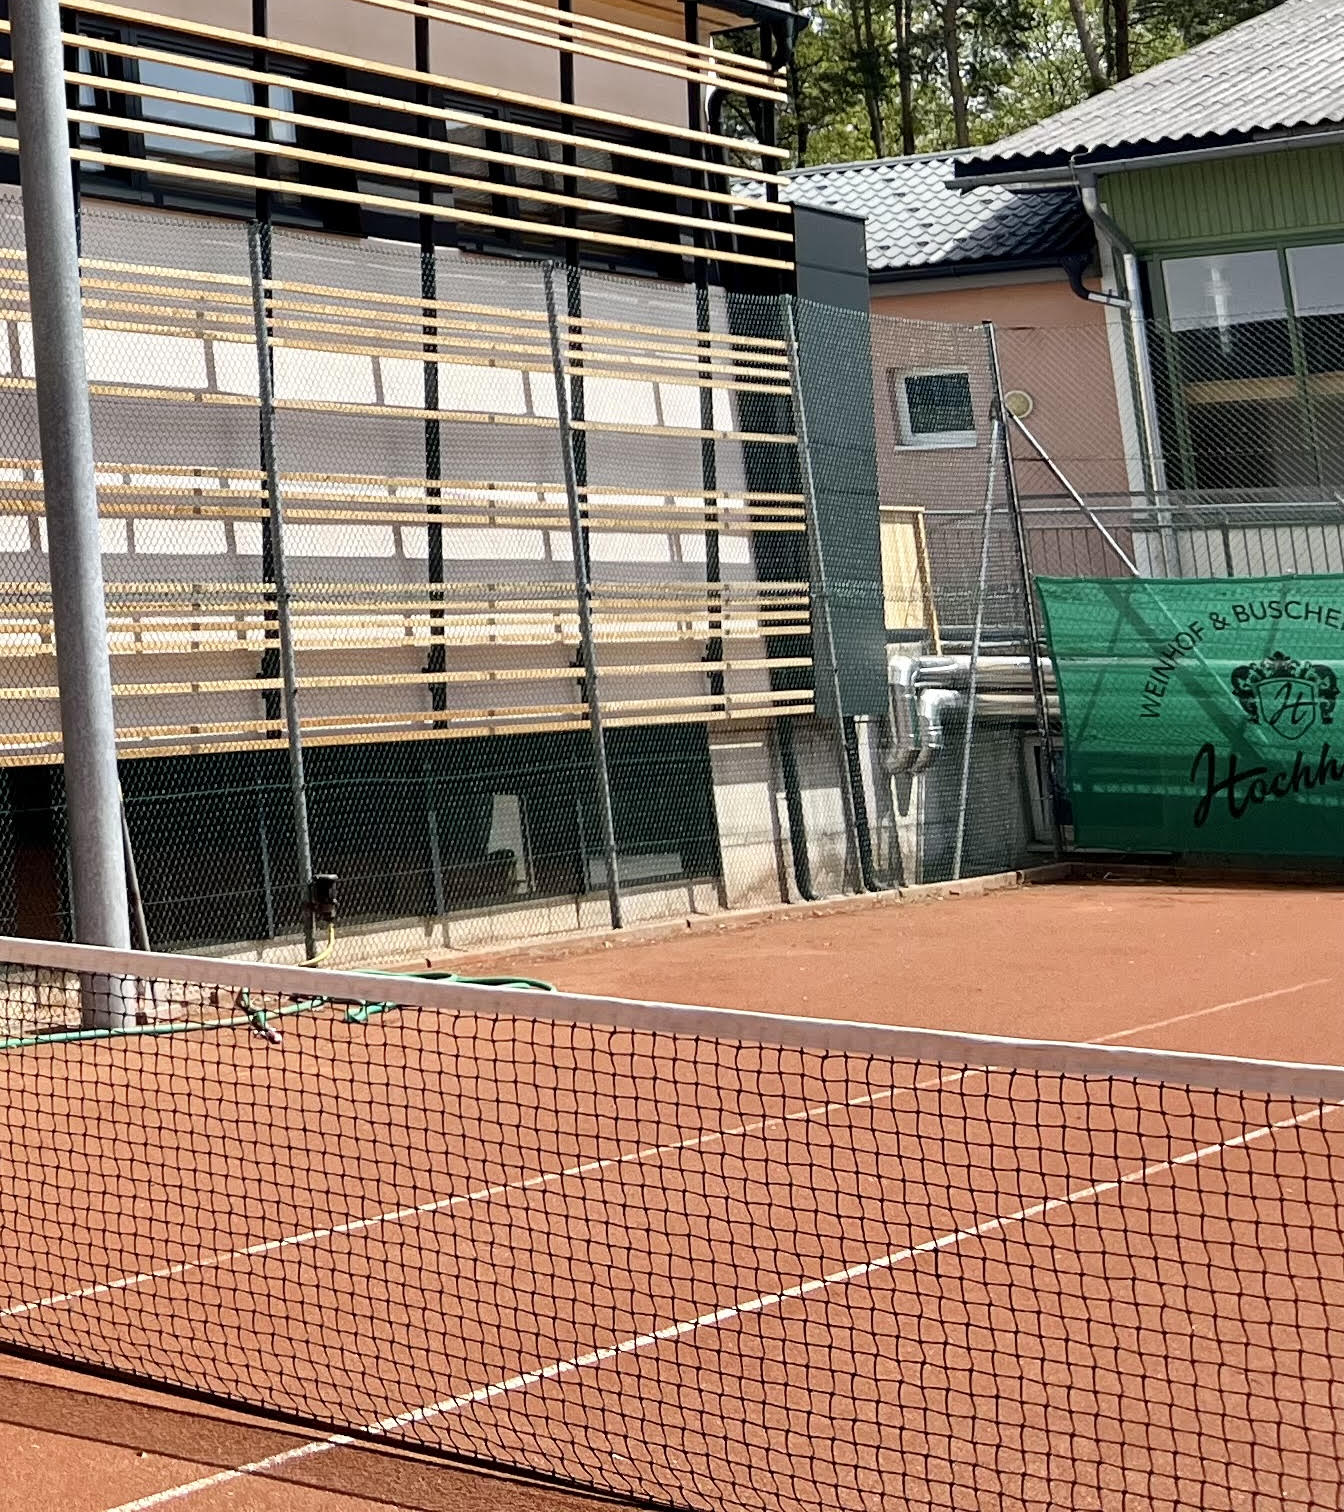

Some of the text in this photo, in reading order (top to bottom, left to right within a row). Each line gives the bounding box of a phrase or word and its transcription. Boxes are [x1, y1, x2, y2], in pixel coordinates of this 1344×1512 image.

[1140, 600, 1344, 718] WEINHOF & BUSCHE
